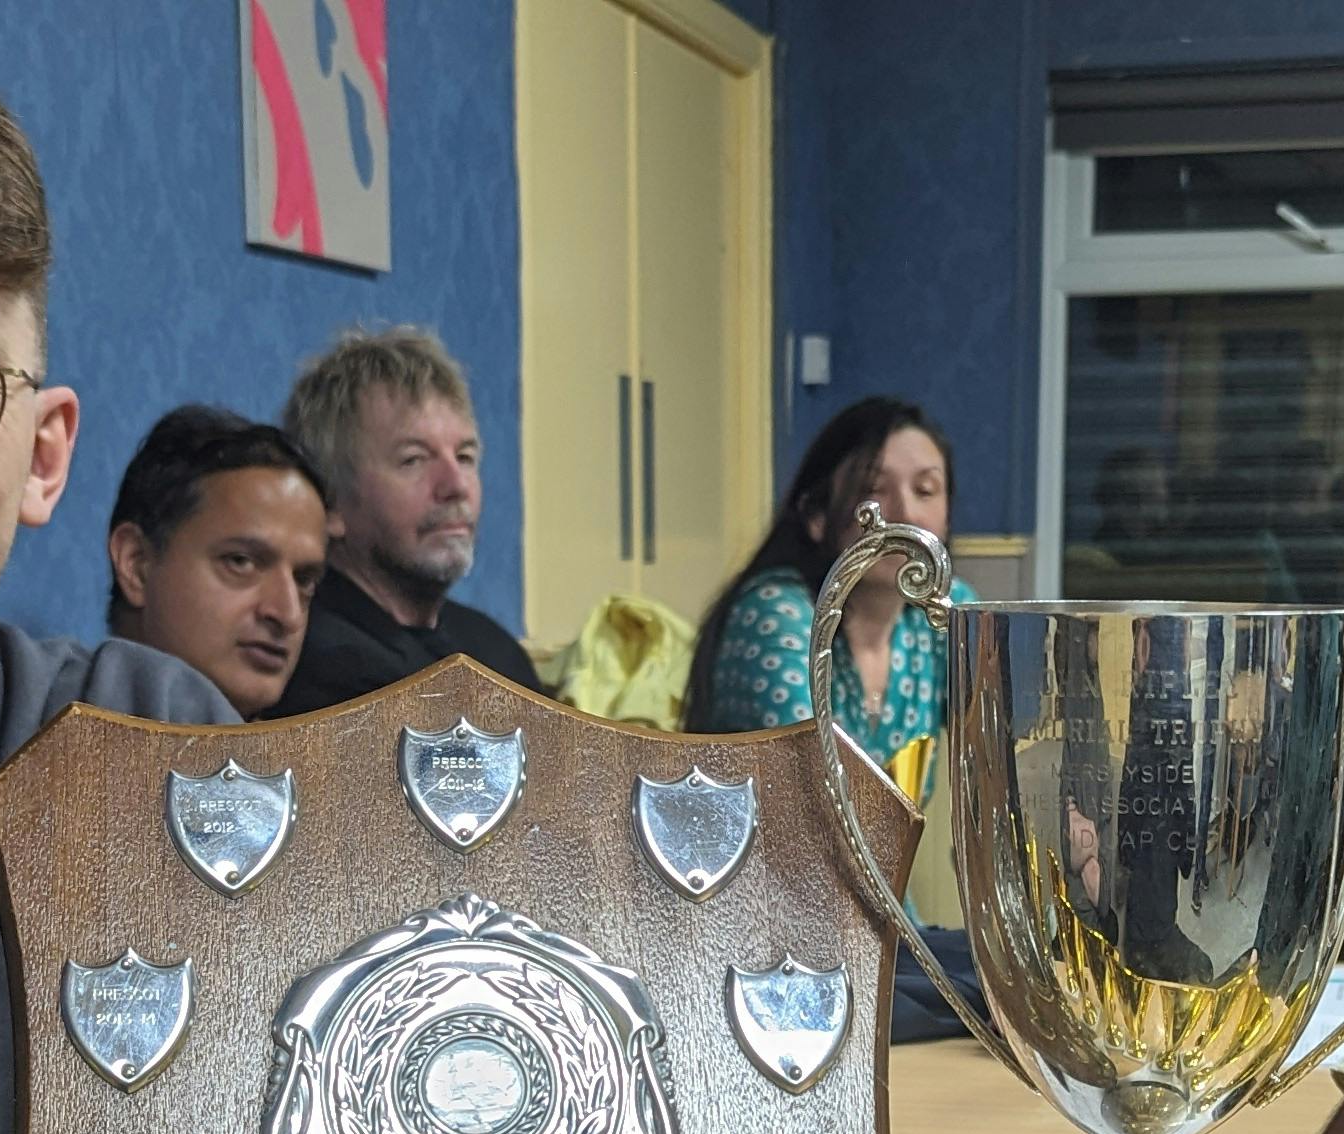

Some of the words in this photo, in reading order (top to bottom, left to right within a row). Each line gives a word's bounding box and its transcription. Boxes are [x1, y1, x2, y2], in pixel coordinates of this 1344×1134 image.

[198, 799, 262, 813] PRESCOT
[1089, 794, 1238, 817] ASSOCIATON
[92, 987, 160, 1001] PRESCOT
